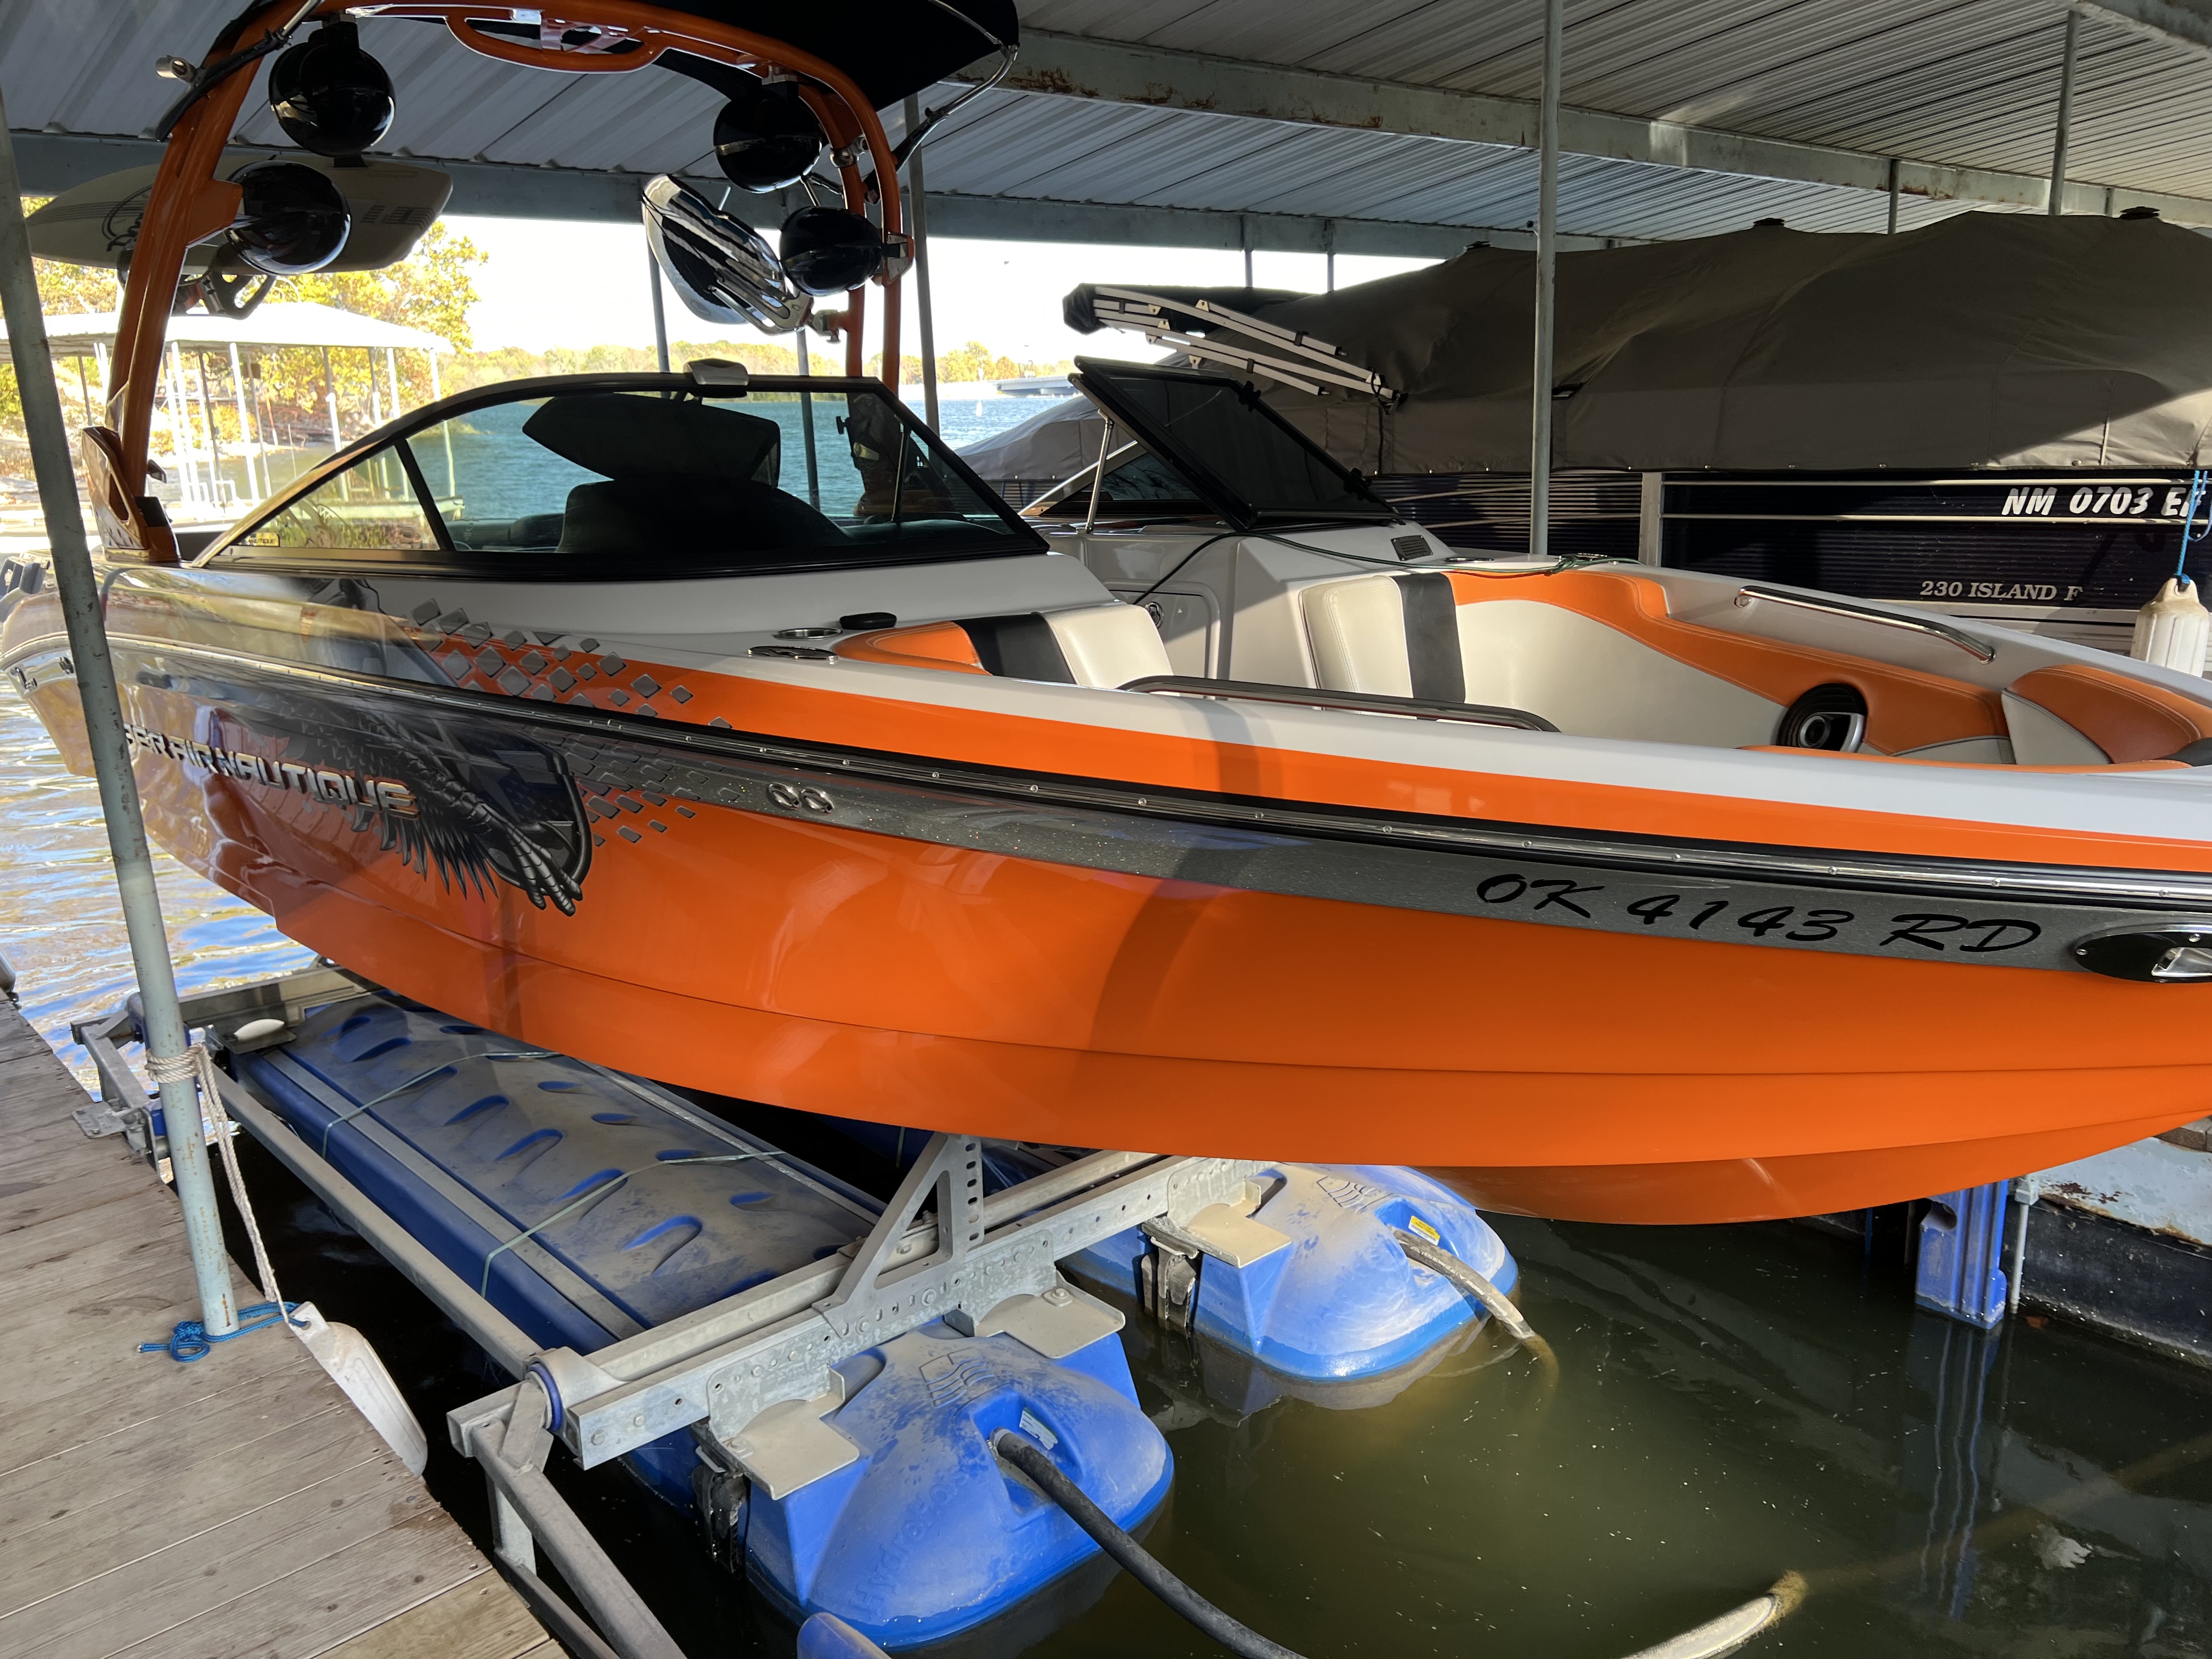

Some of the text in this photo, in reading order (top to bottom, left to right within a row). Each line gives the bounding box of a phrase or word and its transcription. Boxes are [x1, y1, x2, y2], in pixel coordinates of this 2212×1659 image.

[2001, 487, 2057, 516] NM
[2069, 486, 2153, 515] 0703
[1920, 580, 1962, 597] 230
[1967, 582, 2057, 600] ISLAND
[215, 747, 420, 821] NAUTIQUE
[1476, 873, 2041, 952] OK 4143 RD
[848, 1458, 977, 1618] HydroHois
